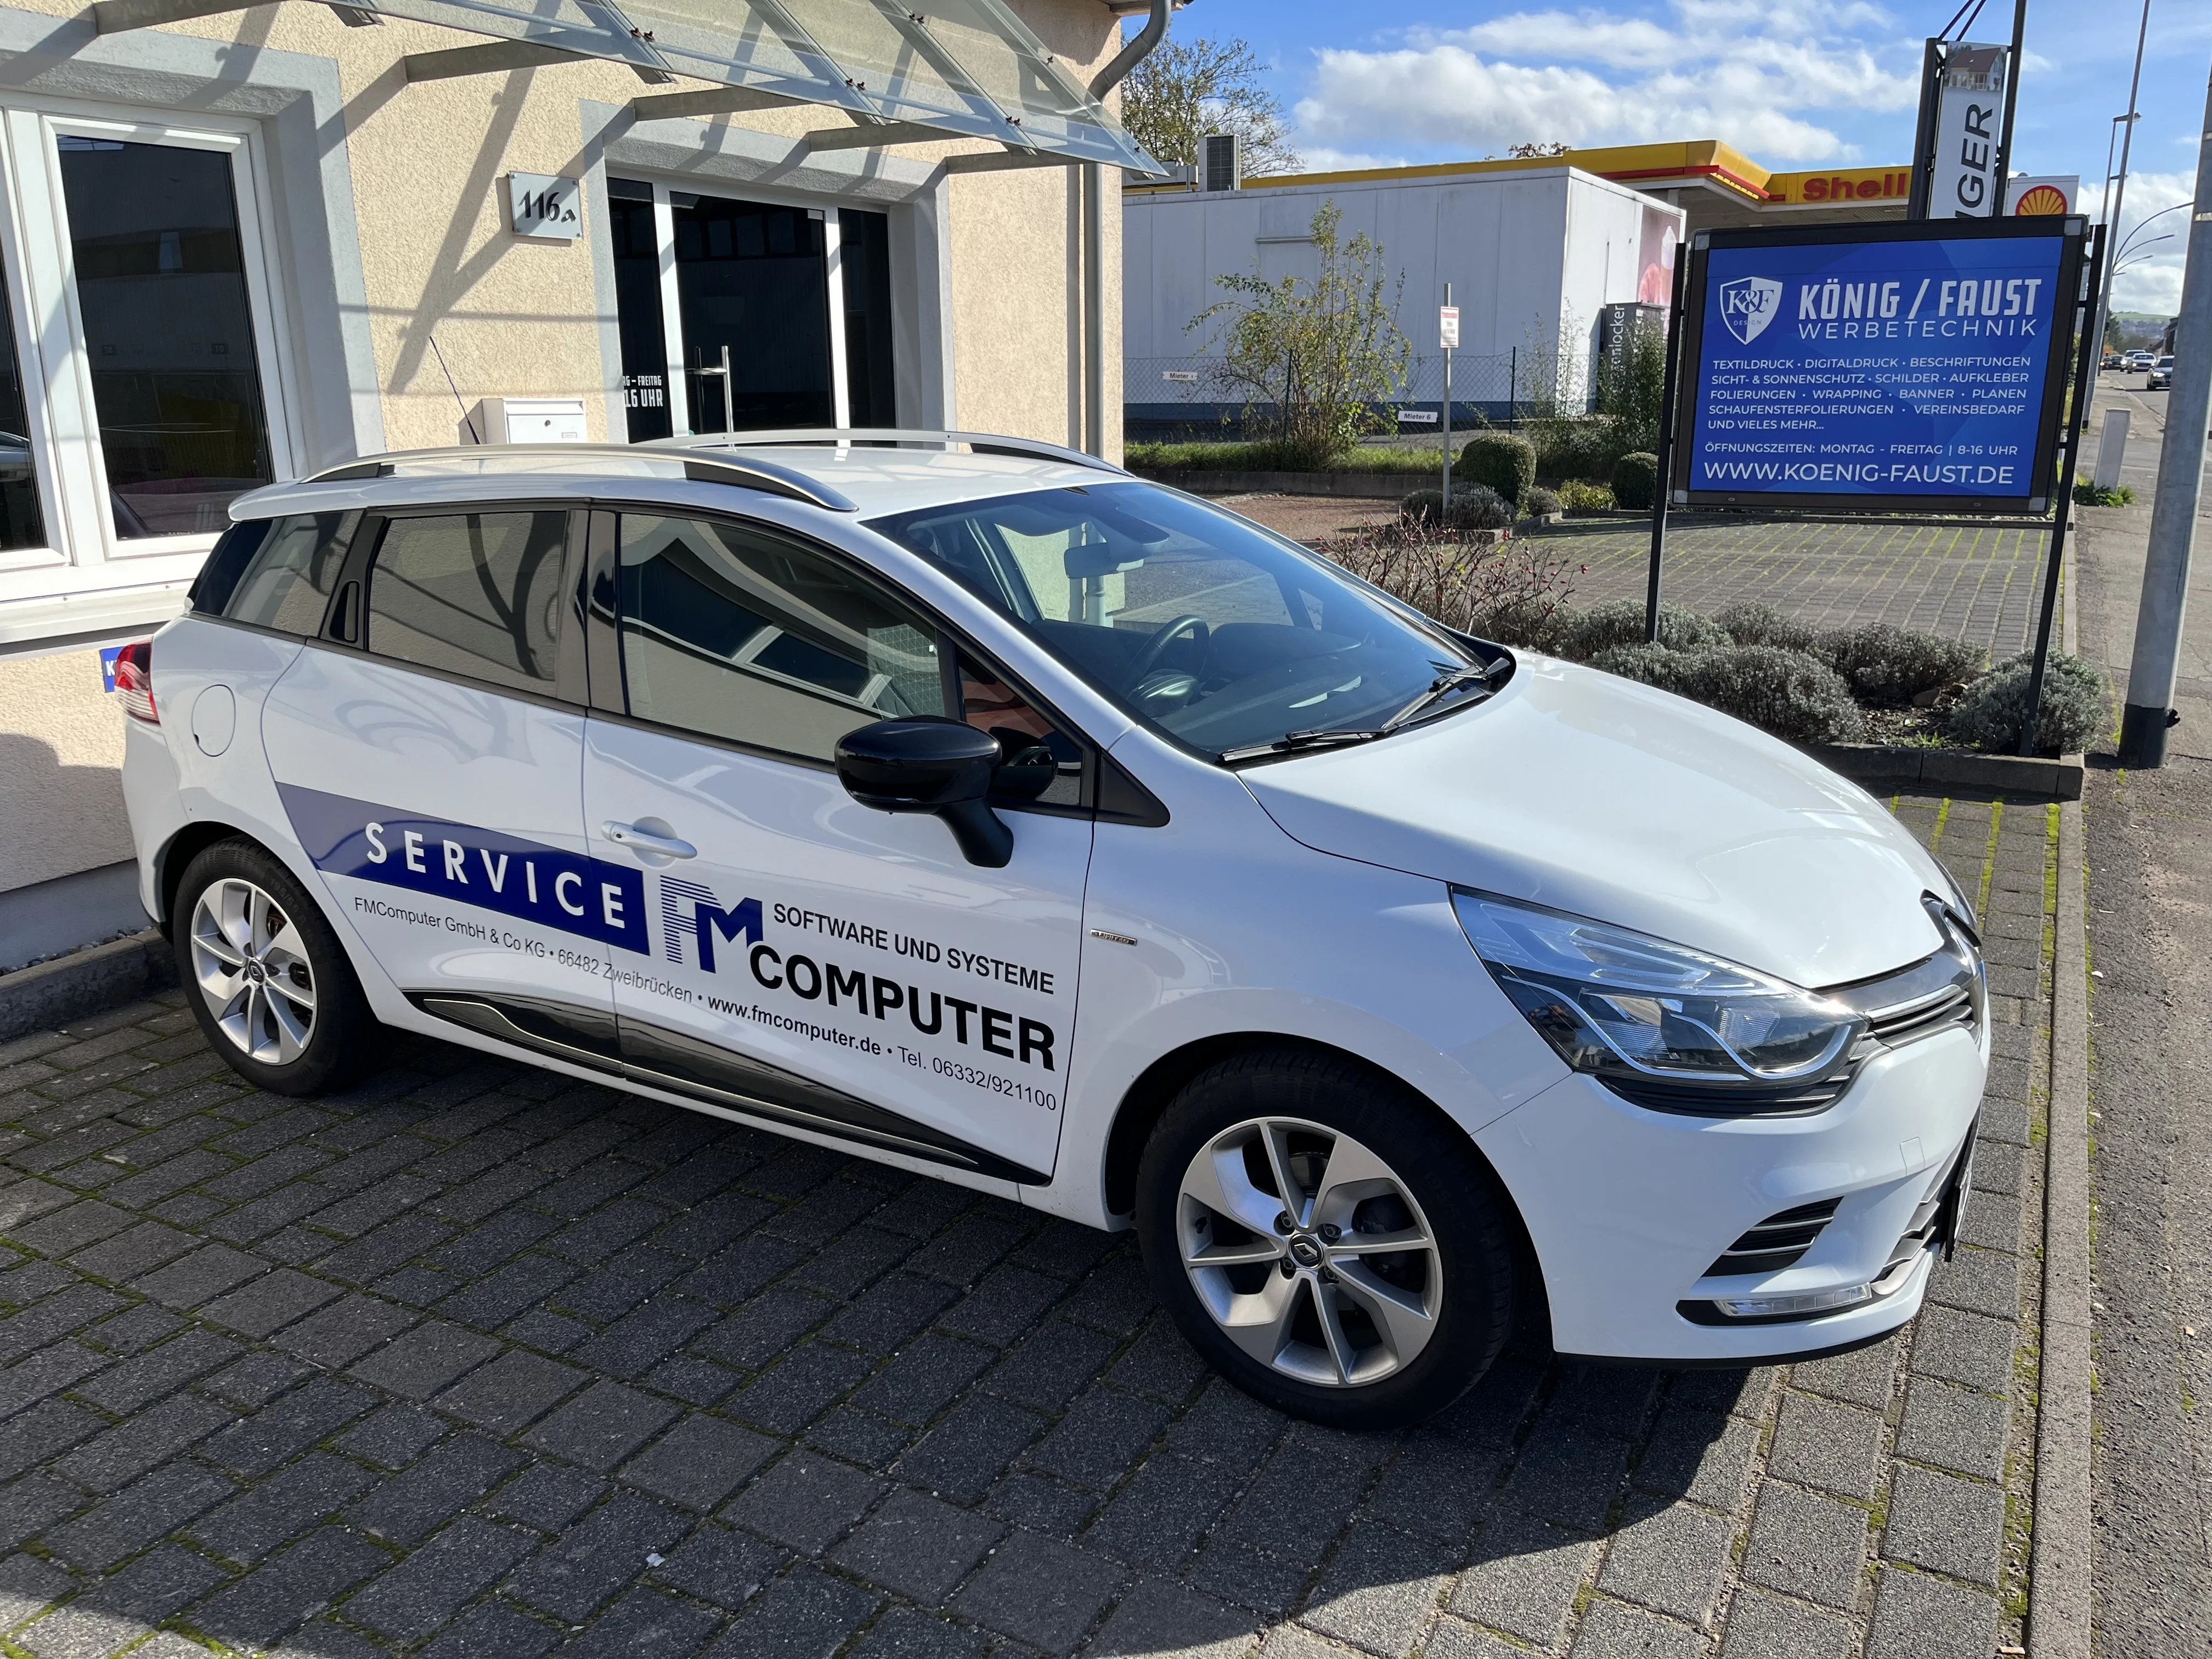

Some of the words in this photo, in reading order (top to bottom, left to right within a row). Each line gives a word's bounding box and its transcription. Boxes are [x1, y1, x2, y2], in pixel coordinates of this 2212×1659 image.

[1955, 104, 1993, 218] GER
[1803, 173, 1907, 201] Shell
[1725, 289, 1775, 314] K&F
[1798, 278, 1900, 320] KÖNIG
[1908, 278, 1931, 320] /
[1938, 279, 2042, 317] FAUST
[1798, 319, 2037, 340] WERBETECHNIK
[1713, 359, 1794, 370] TEXTILDRUCK
[1804, 358, 1899, 369] DIGITALDRUCK
[1910, 357, 2030, 368] BESCHRIFTUNGEN
[637, 375, 662, 386] FREITAG
[1711, 375, 1750, 385] SICHT-
[1752, 375, 1760, 384] &
[1763, 374, 1865, 384] SONNENSCHUTZ
[1875, 373, 1939, 383] SCHILDER
[1949, 373, 2029, 383] AUFKLEBER
[640, 388, 663, 407] UHR
[1710, 390, 1796, 399] FOLIERUNGEN
[1813, 390, 1882, 399] WRAPPING
[1899, 389, 1955, 399] BANNER
[1972, 389, 2027, 398] PLANEN
[1709, 405, 1893, 415] SCHAUFENSTERFOLIERUNGEN
[1914, 405, 2025, 415] VEREINSBEDARF
[1708, 420, 1735, 430] UND
[1737, 420, 1778, 430] VIELES
[1780, 420, 1825, 430] MEHR...
[1705, 441, 1815, 453] ÖFFNUNGSZEITEN:
[1820, 444, 1875, 454] MONTAG
[1890, 444, 1943, 454] FREITAG
[1957, 445, 1983, 455] 8-16
[1989, 445, 2018, 455] UHR
[1704, 462, 2015, 484] WWW.KOENIG-FAUST.DE
[105, 660, 117, 676] K
[365, 822, 625, 929] SERVICE
[774, 903, 888, 950] SOFTWARE
[894, 934, 940, 963] UND
[947, 948, 1054, 995] SYSTEME
[354, 897, 441, 928] FMComputer
[445, 917, 486, 940] GmbH
[490, 928, 499, 944] &
[503, 933, 521, 950] Co
[525, 939, 545, 958] KG
[558, 949, 598, 975] 66482
[603, 963, 692, 1002] Zweibrücken
[708, 996, 881, 1056] www.fmcomputer.de
[898, 1046, 927, 1069] Tel.
[933, 1057, 1056, 1111] 06332/921100
[749, 945, 1056, 1072] COMPUTER
